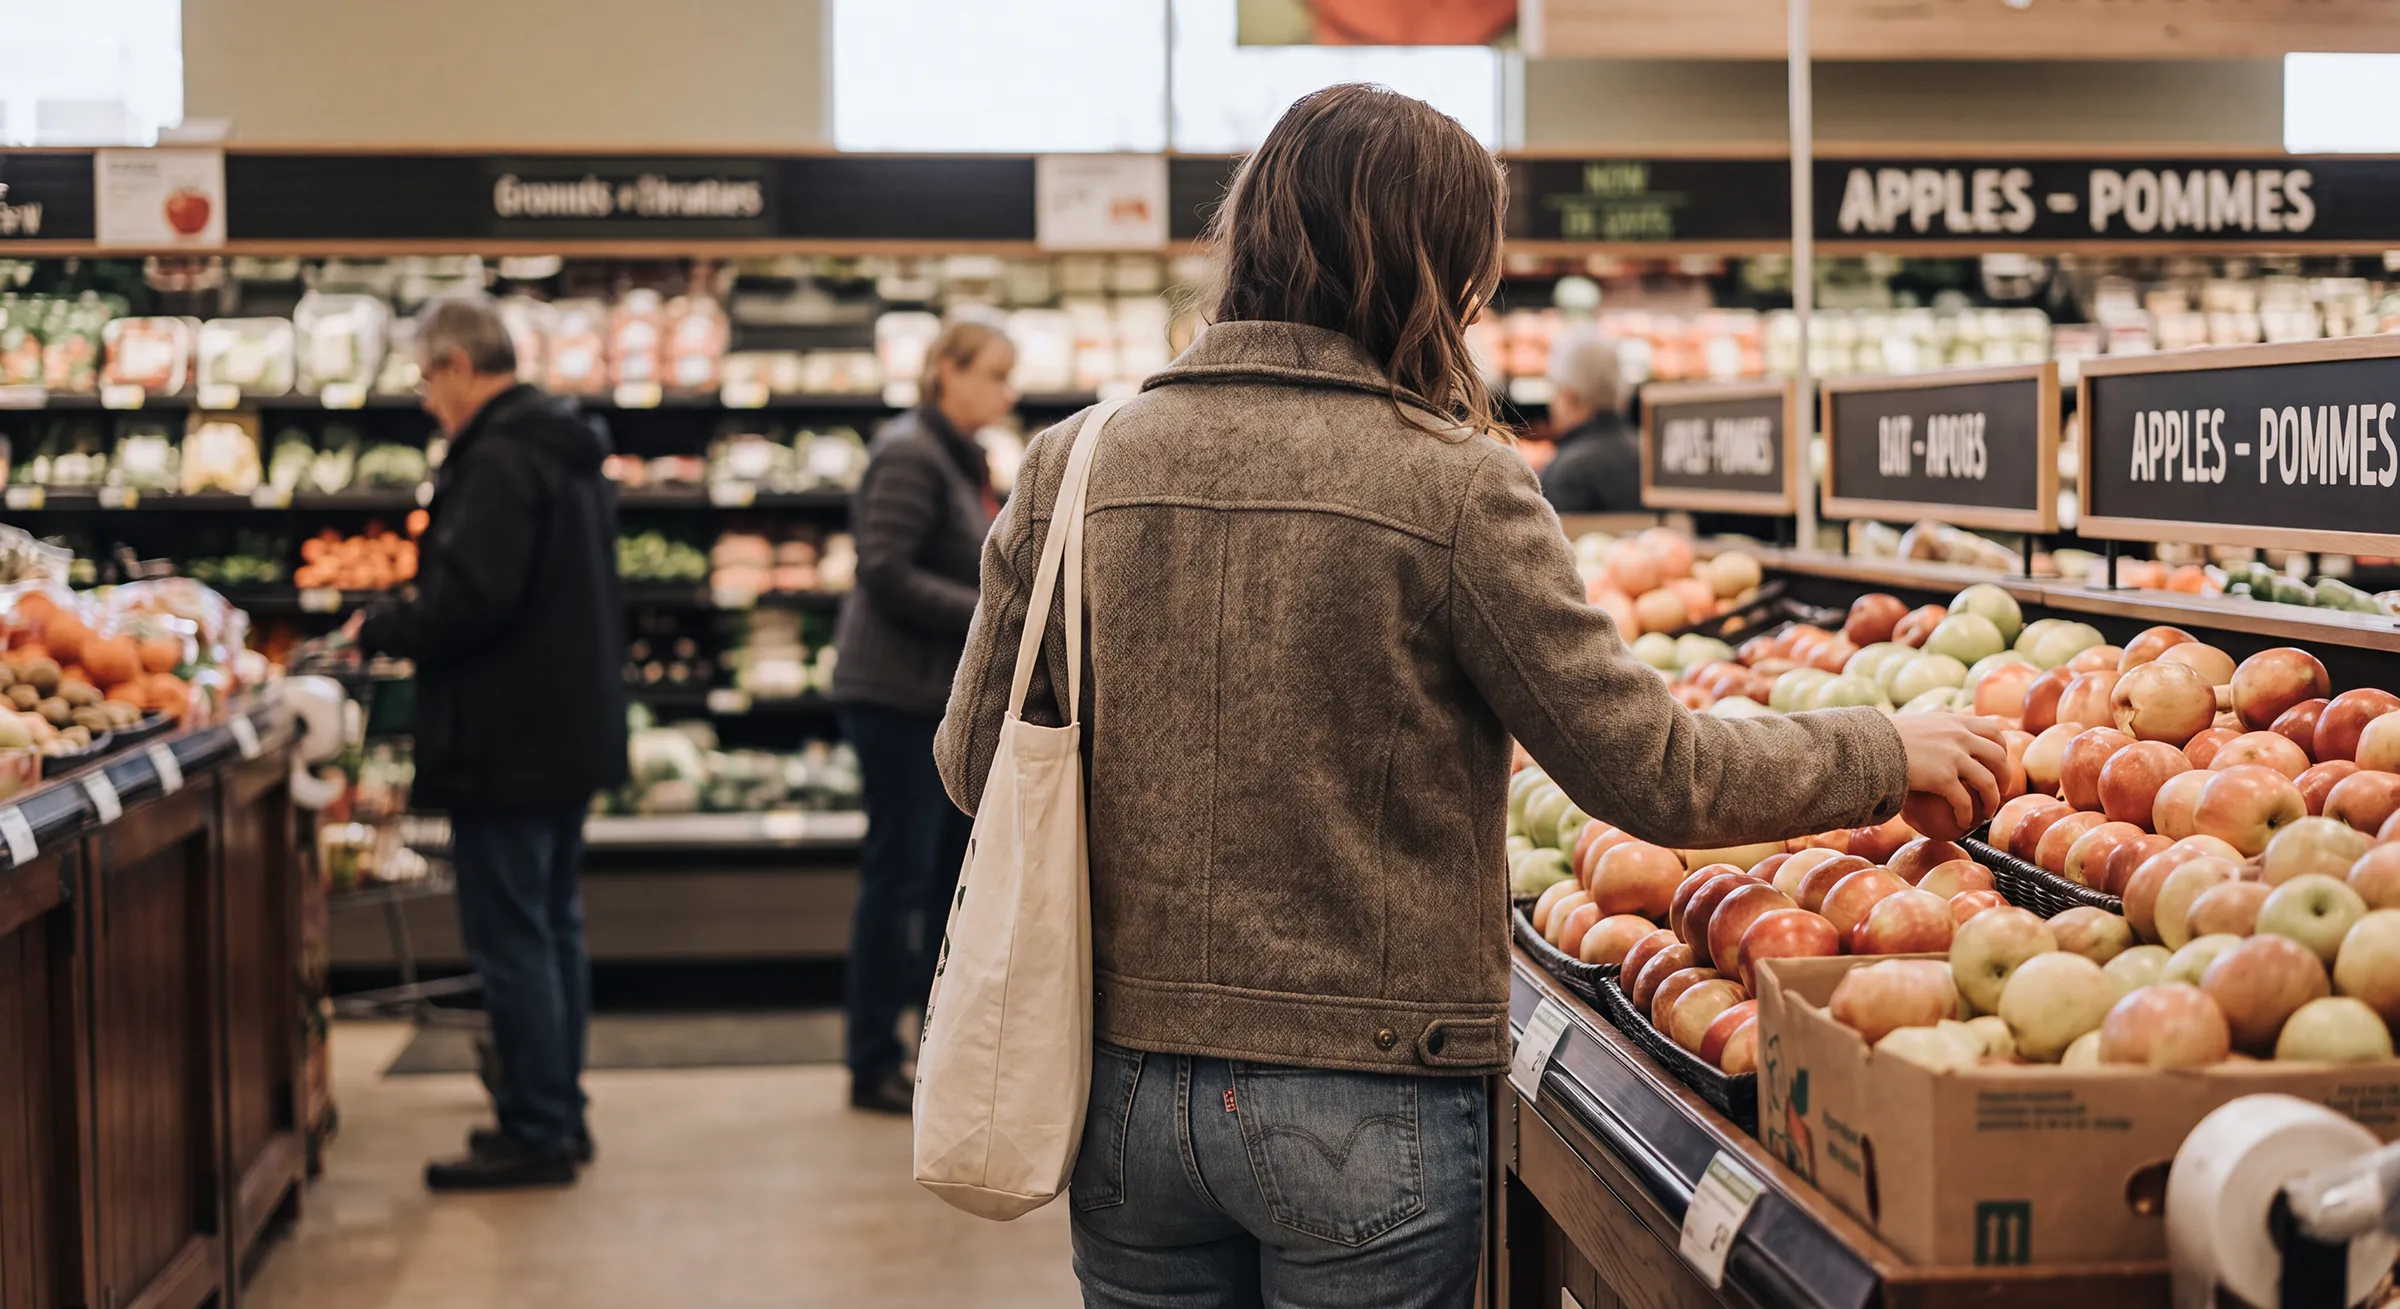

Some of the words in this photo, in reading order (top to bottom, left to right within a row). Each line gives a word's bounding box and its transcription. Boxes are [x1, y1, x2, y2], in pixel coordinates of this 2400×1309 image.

[1837, 167, 2036, 233] APPLES
[2089, 168, 2316, 233] POMMES
[2130, 408, 2227, 484] APPLES
[2259, 402, 2398, 488] POMMES
